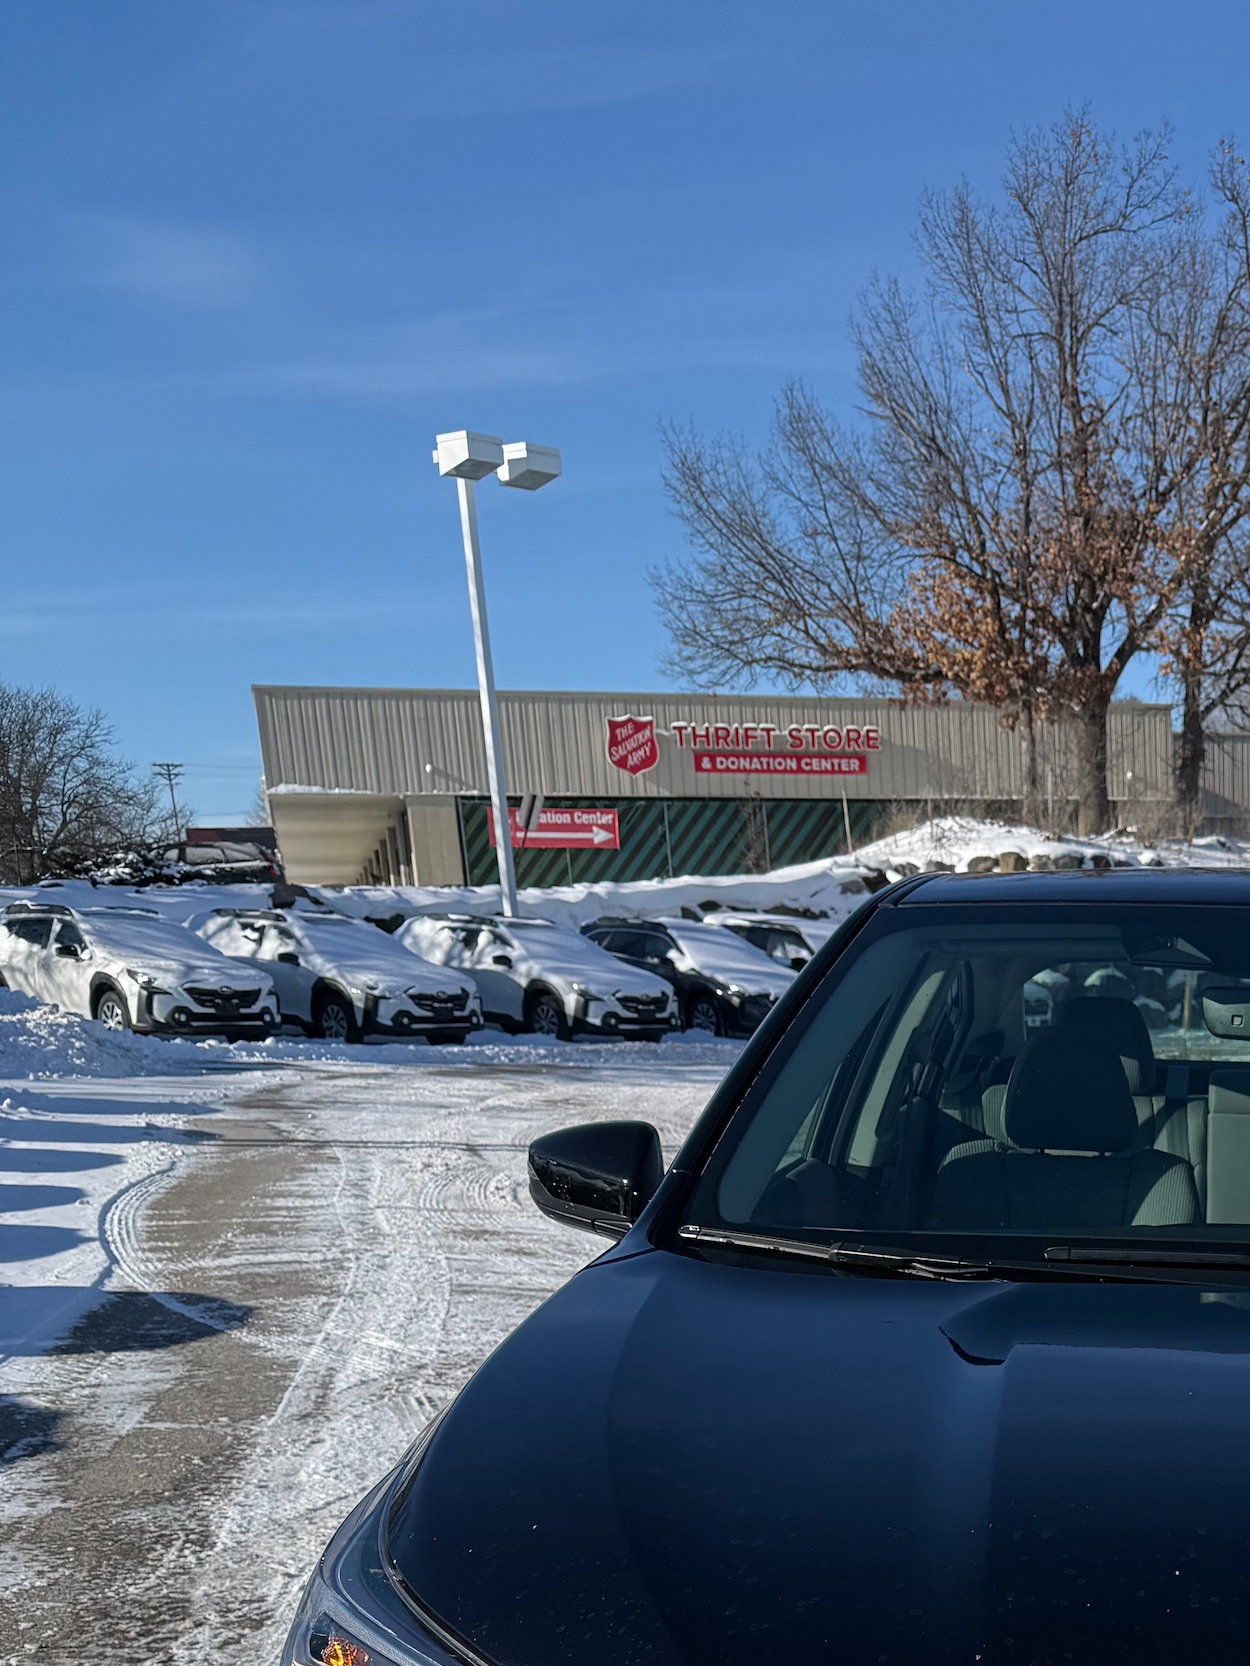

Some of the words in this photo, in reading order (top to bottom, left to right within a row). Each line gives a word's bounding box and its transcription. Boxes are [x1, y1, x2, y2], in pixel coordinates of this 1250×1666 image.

[615, 722, 636, 741] THE
[671, 723, 777, 750] THRIFT
[786, 725, 880, 751] STORE
[610, 724, 652, 762] SALVATION
[626, 742, 652, 768] ARMY
[701, 756, 712, 769] &
[716, 757, 797, 770] DONATION
[801, 758, 860, 771] CENTER
[574, 811, 613, 825] Center
